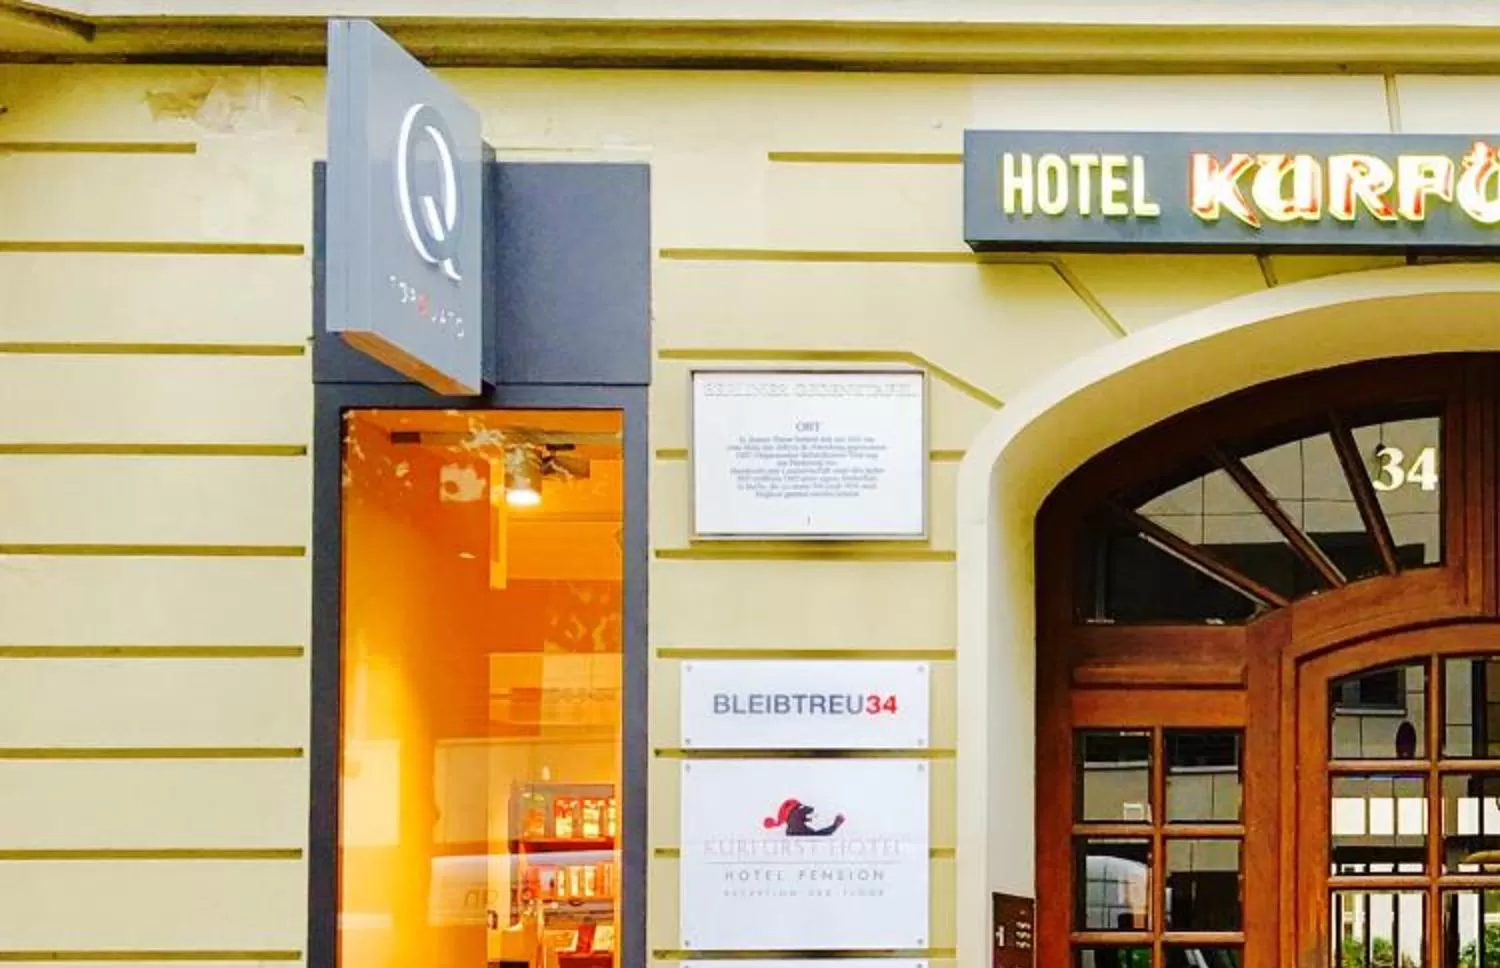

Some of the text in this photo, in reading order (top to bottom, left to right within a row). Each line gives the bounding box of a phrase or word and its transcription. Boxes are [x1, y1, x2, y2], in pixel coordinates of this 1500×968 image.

[397, 102, 463, 282] Q
[1001, 152, 1161, 218] HOTEL
[1371, 446, 1440, 492] 34
[712, 693, 898, 716] BLEIBTREU34
[724, 868, 885, 881] HOTEL PENSION
